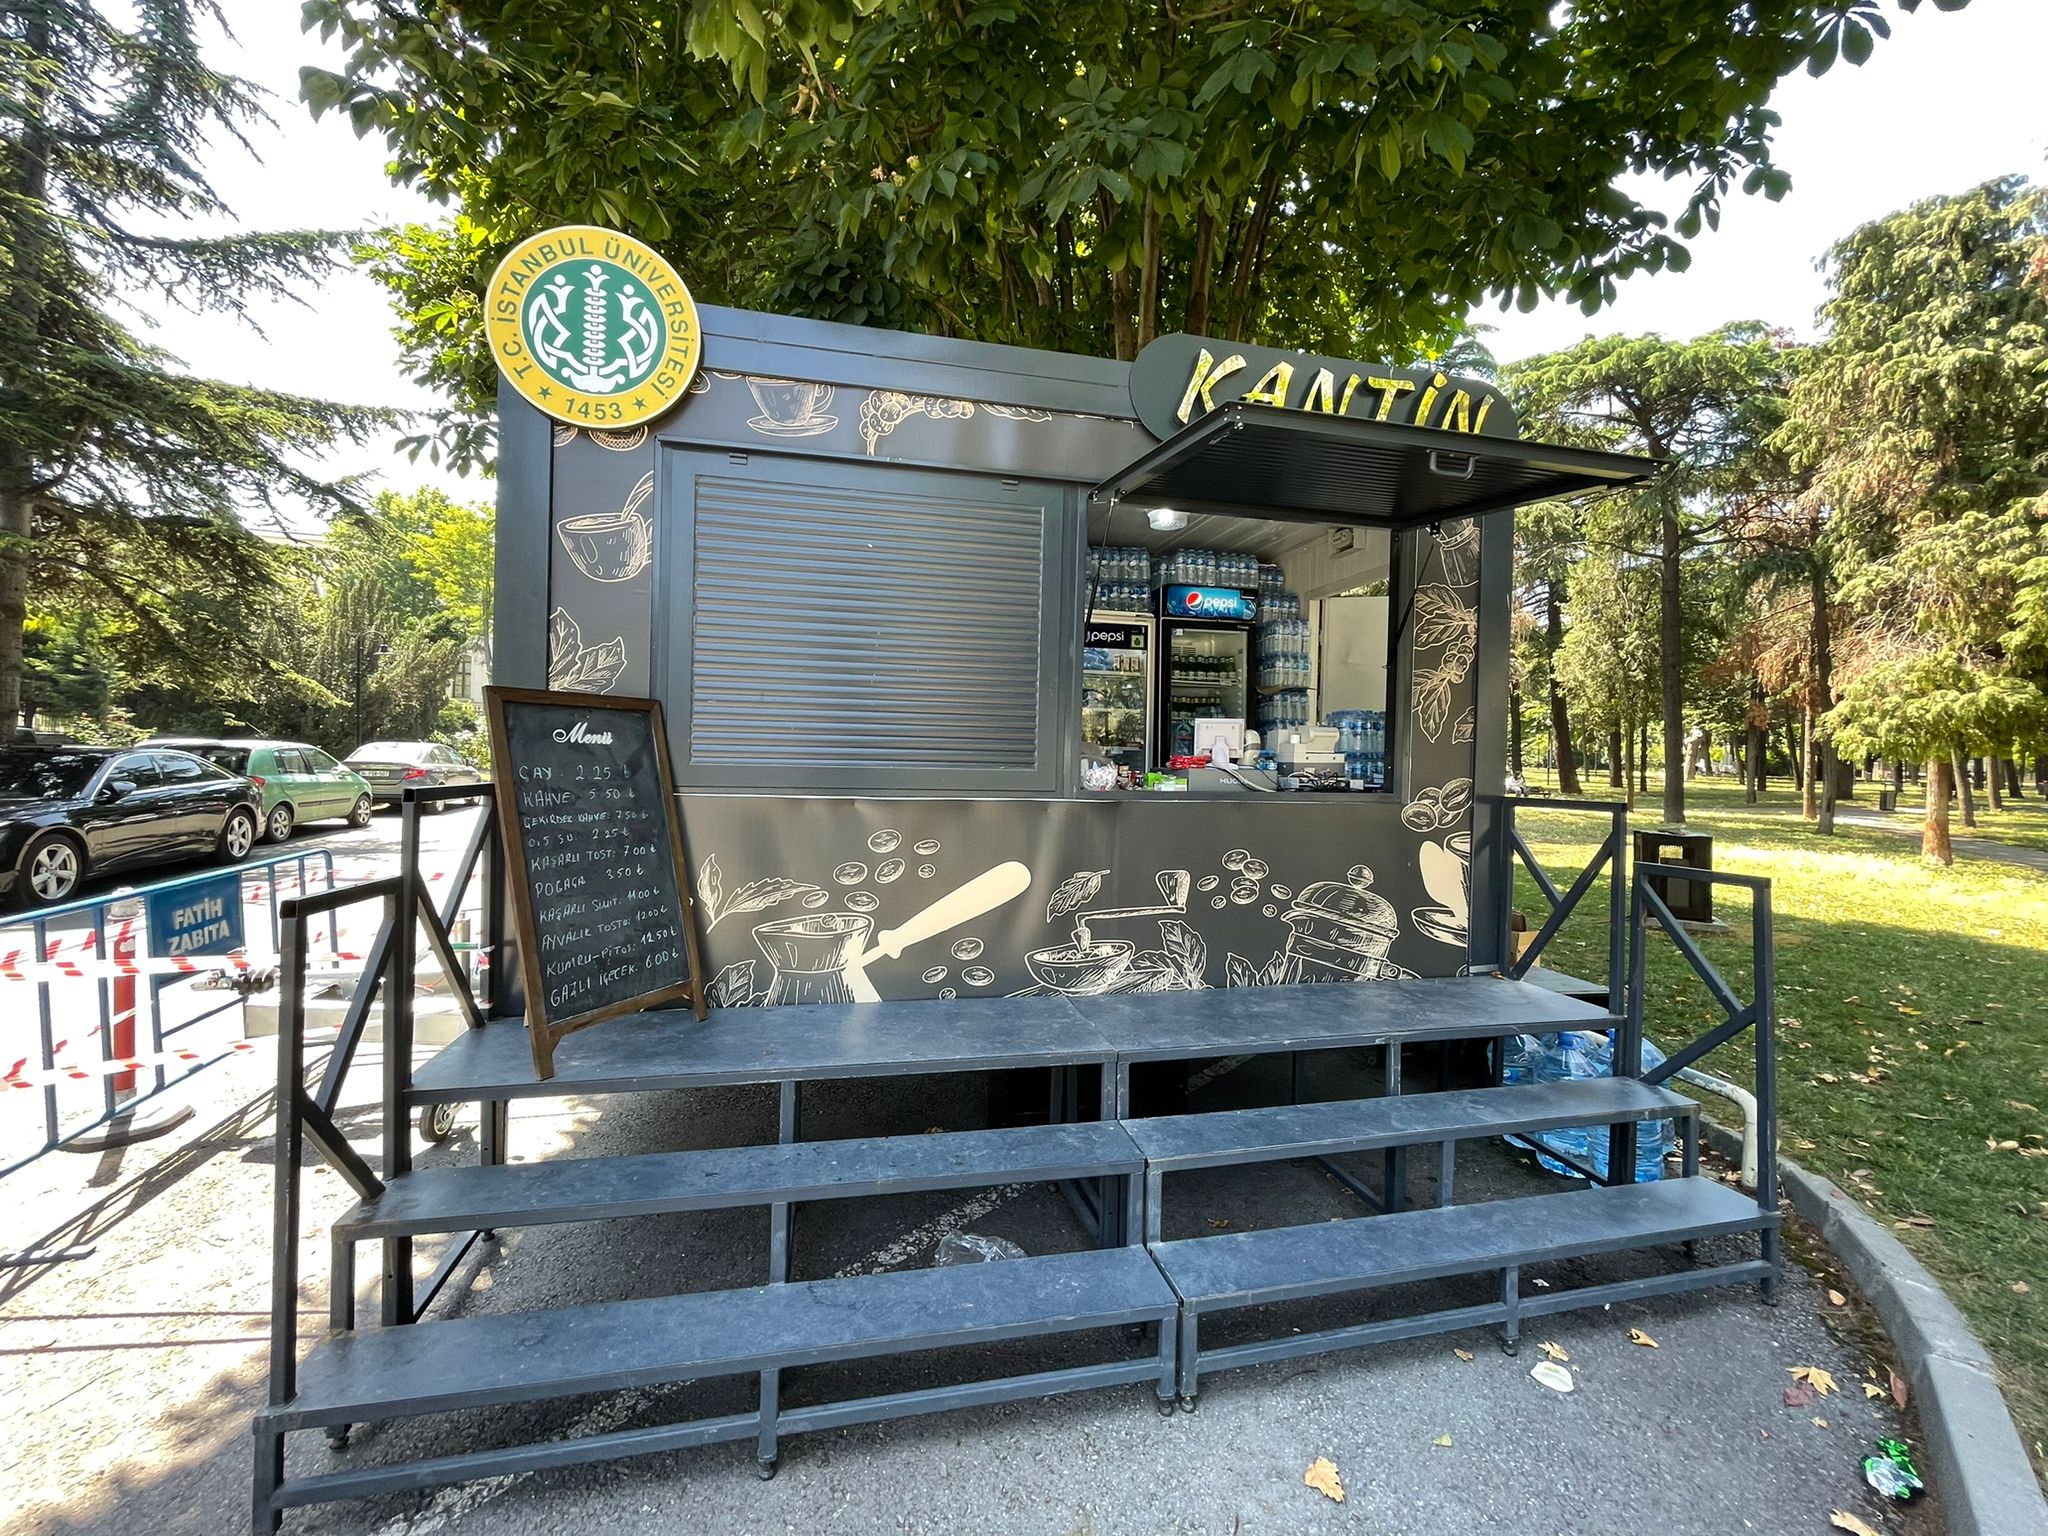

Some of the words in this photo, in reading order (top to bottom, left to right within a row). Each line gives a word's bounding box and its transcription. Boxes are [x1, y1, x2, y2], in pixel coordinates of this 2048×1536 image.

[491, 237, 593, 323] İSTANBUL
[604, 237, 695, 400] ÜNİVERSİTESİ
[503, 331, 533, 381] T.C.
[565, 397, 623, 420] 1453
[1175, 348, 1495, 434] KANTİN
[1203, 596, 1238, 609] pepsi
[1091, 631, 1125, 642] pepsi
[552, 721, 613, 745] Menü
[172, 897, 223, 930] FATİH
[166, 920, 231, 957] ZABITA
